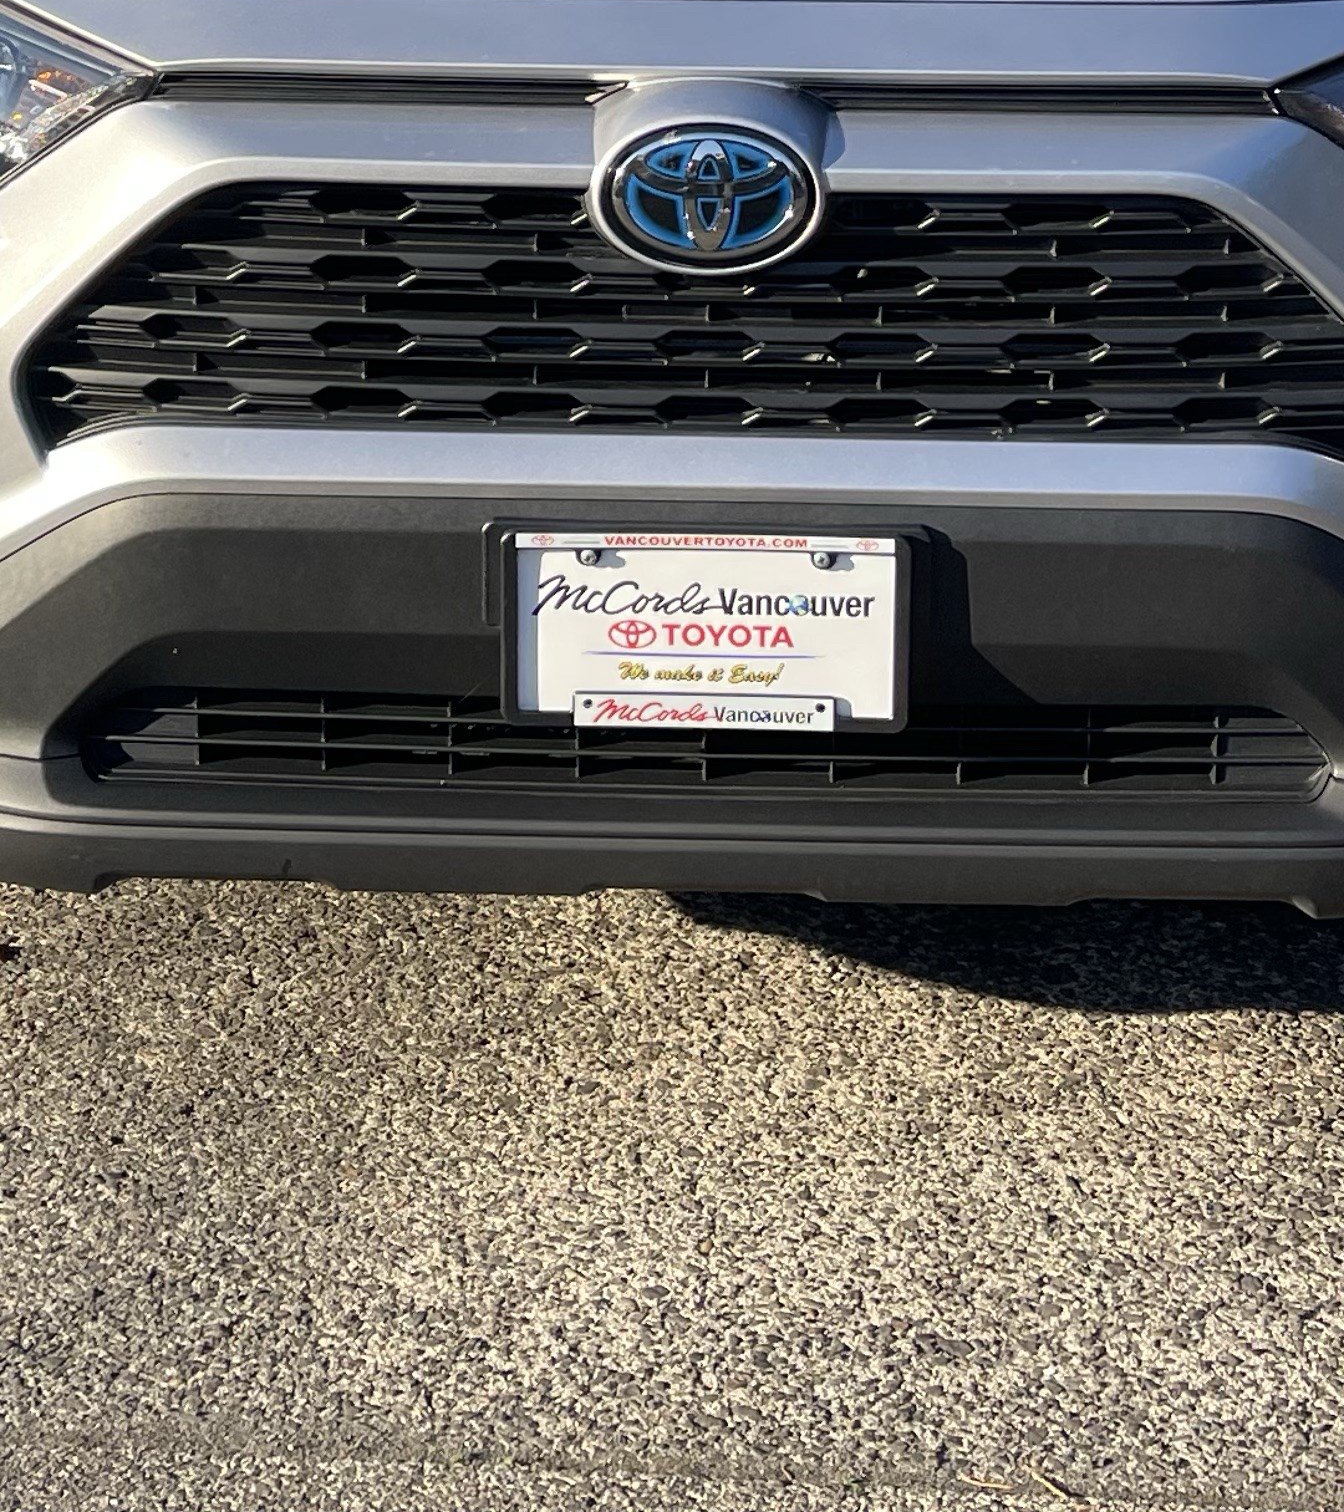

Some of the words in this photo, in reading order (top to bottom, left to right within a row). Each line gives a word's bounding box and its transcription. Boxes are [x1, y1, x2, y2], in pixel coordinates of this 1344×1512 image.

[604, 535, 808, 549] VANCOUVERTOYOTA.COM
[662, 624, 795, 648] TOYOTA
[619, 661, 649, 681] We
[654, 664, 703, 682] make
[728, 663, 785, 688] Easy!
